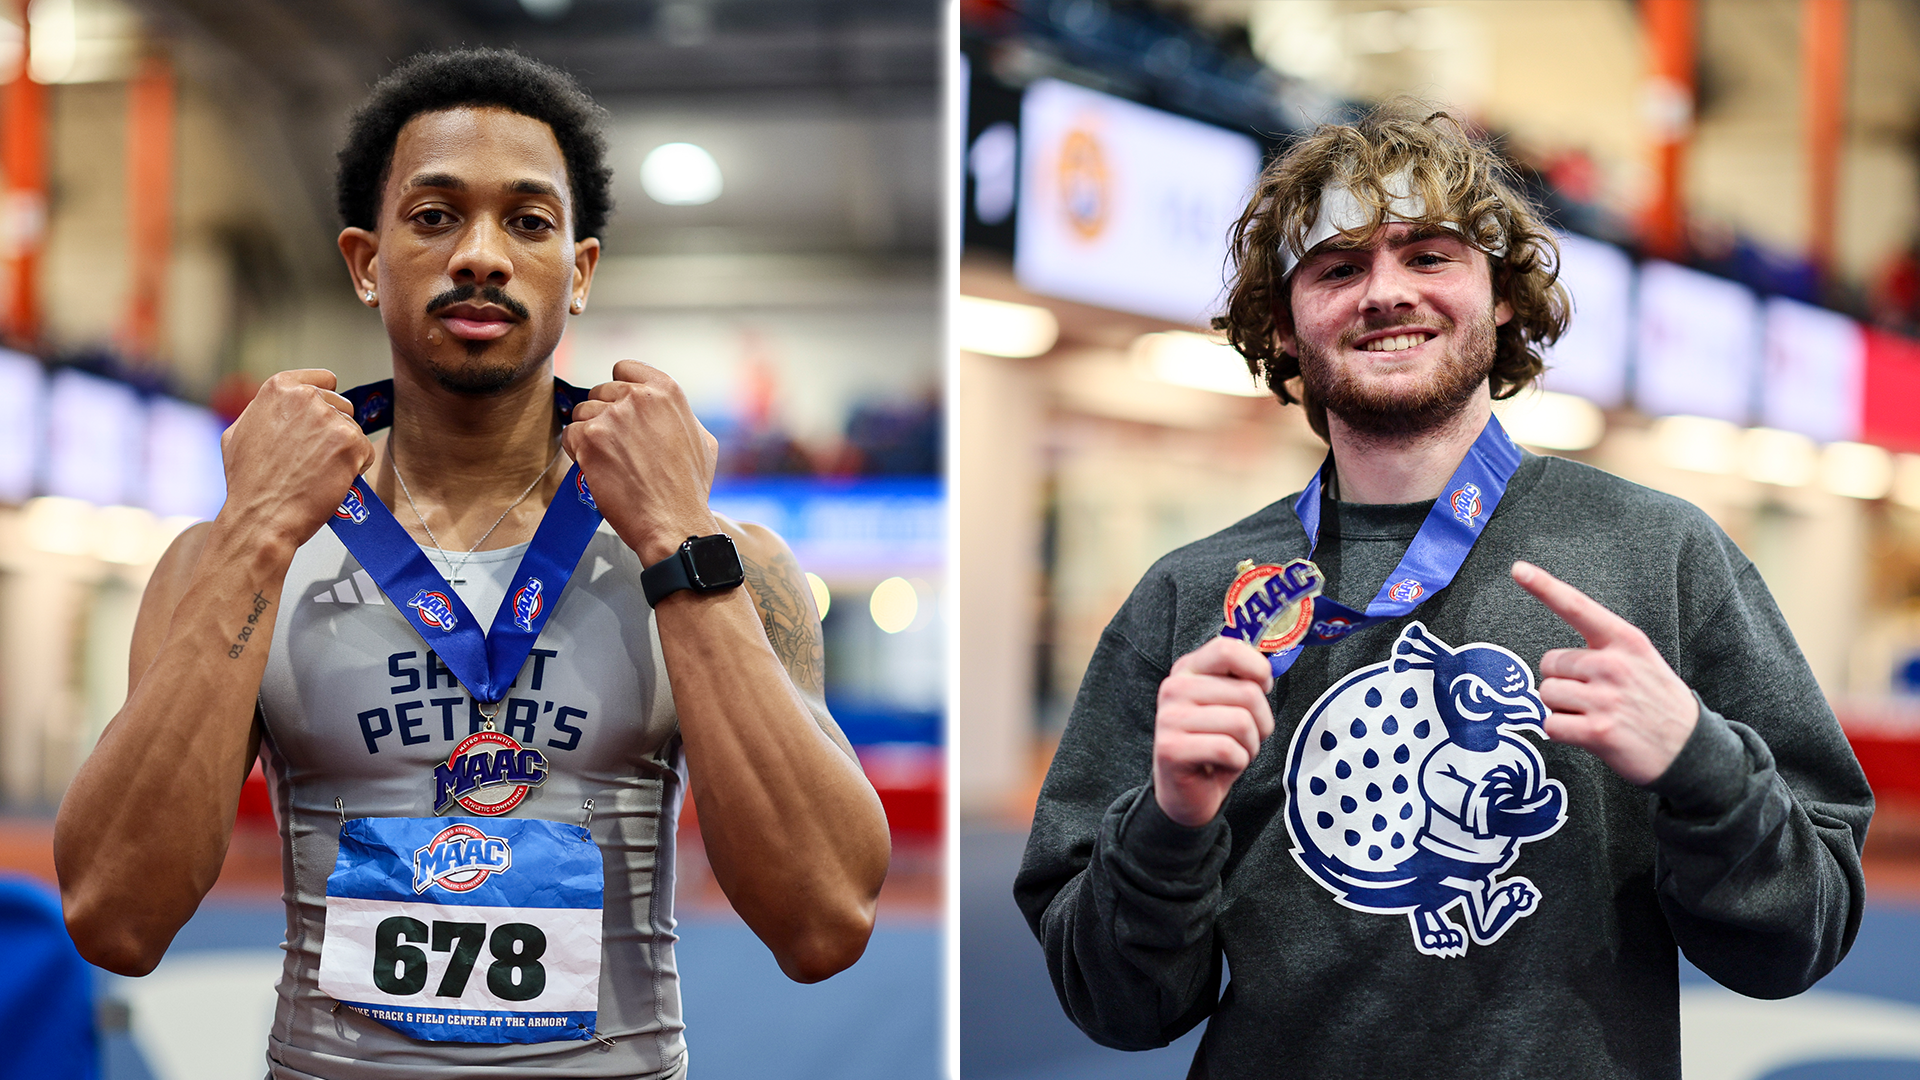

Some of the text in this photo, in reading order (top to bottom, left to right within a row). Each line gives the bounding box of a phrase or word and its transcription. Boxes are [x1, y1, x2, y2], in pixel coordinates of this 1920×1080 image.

[1454, 483, 1481, 527] MAAC
[408, 590, 456, 632] MAAC
[514, 578, 543, 632] MAAC
[387, 648, 558, 695] SAT
[458, 734, 513, 753] METRO ATLANTIC
[433, 747, 549, 816] MAAC
[414, 837, 511, 893] MAAC
[373, 915, 548, 1001] 678
[371, 1009, 404, 1022] TRACK
[406, 1012, 414, 1022] &
[415, 1013, 445, 1025] FIELD
[447, 1014, 488, 1026] CENTER
[489, 1016, 502, 1027] AT
[505, 1016, 526, 1027] THE
[527, 1016, 569, 1028] ARMORY
